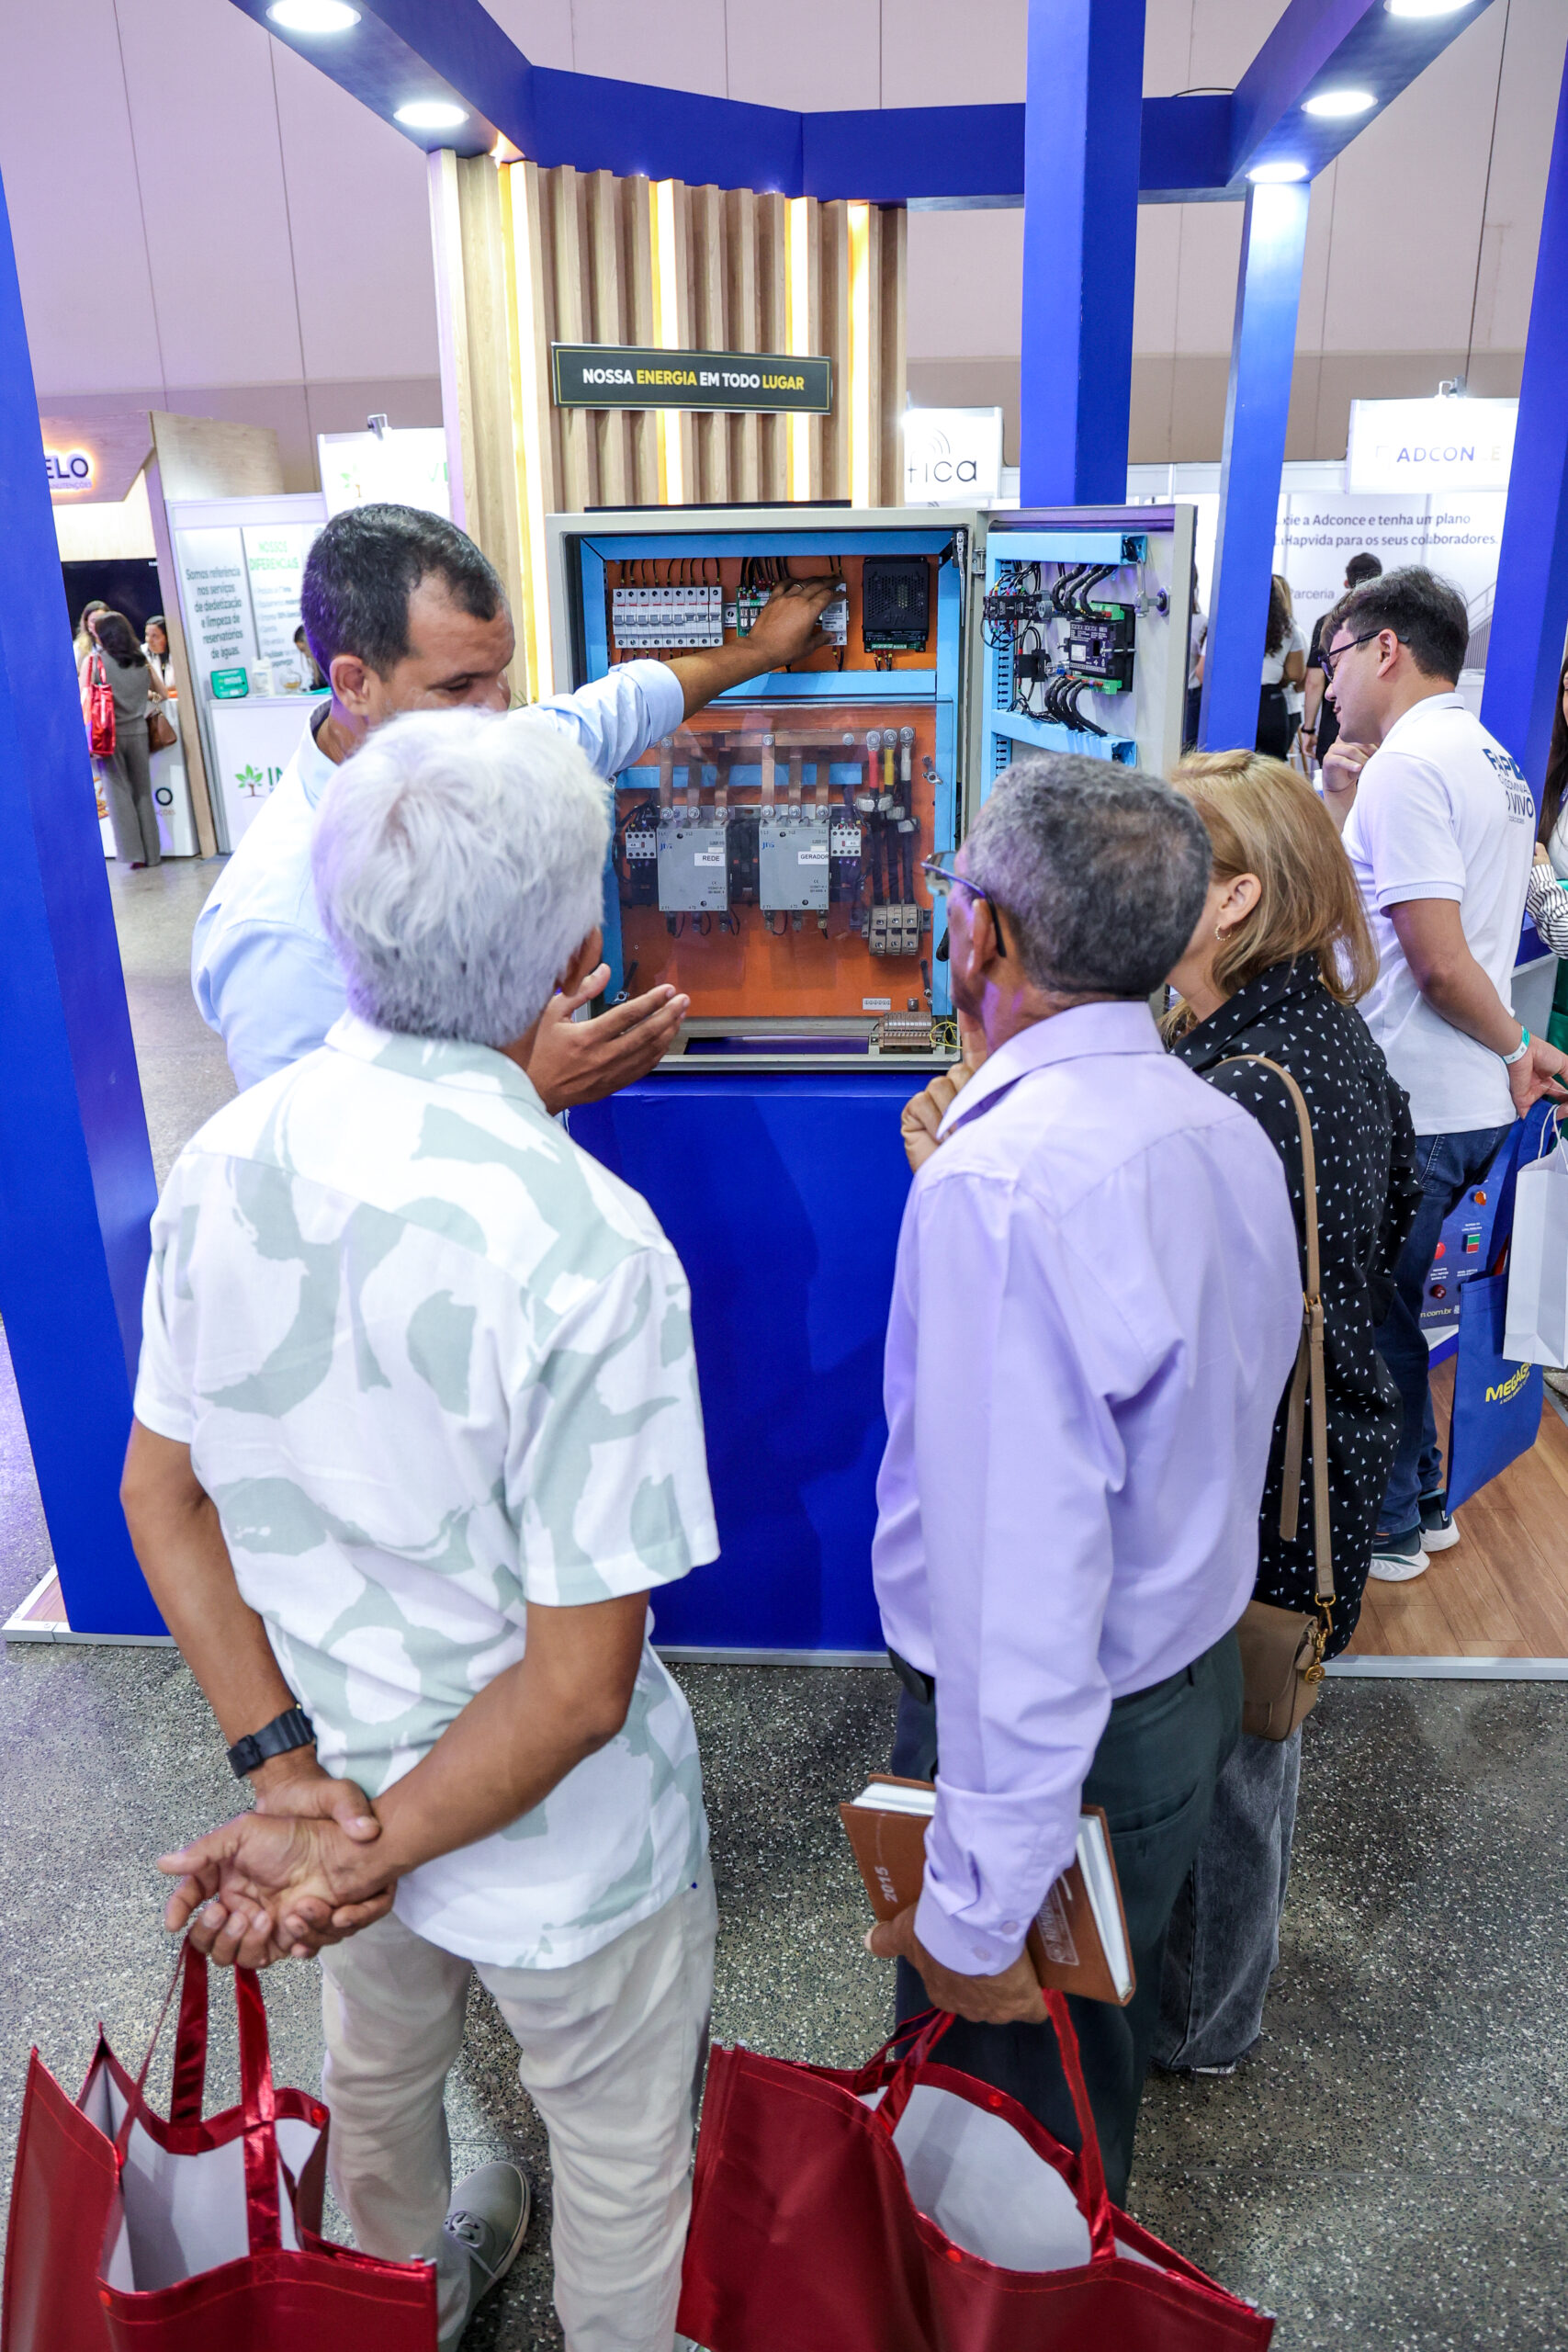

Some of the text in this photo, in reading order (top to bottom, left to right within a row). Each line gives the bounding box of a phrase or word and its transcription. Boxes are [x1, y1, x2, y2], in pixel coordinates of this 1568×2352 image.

[582, 368, 805, 390] NOSSA ENERGIA EM TODO LUGAR
[1396, 445, 1502, 464] ADCONE
[1312, 514, 1366, 526] Adconce
[1368, 516, 1376, 526] e
[1378, 513, 1414, 526] tenha
[1436, 513, 1471, 527] plano
[1336, 537, 1363, 548] para
[1365, 537, 1379, 546] os
[1382, 536, 1409, 546] seus
[874, 1865, 898, 1904] 2015
